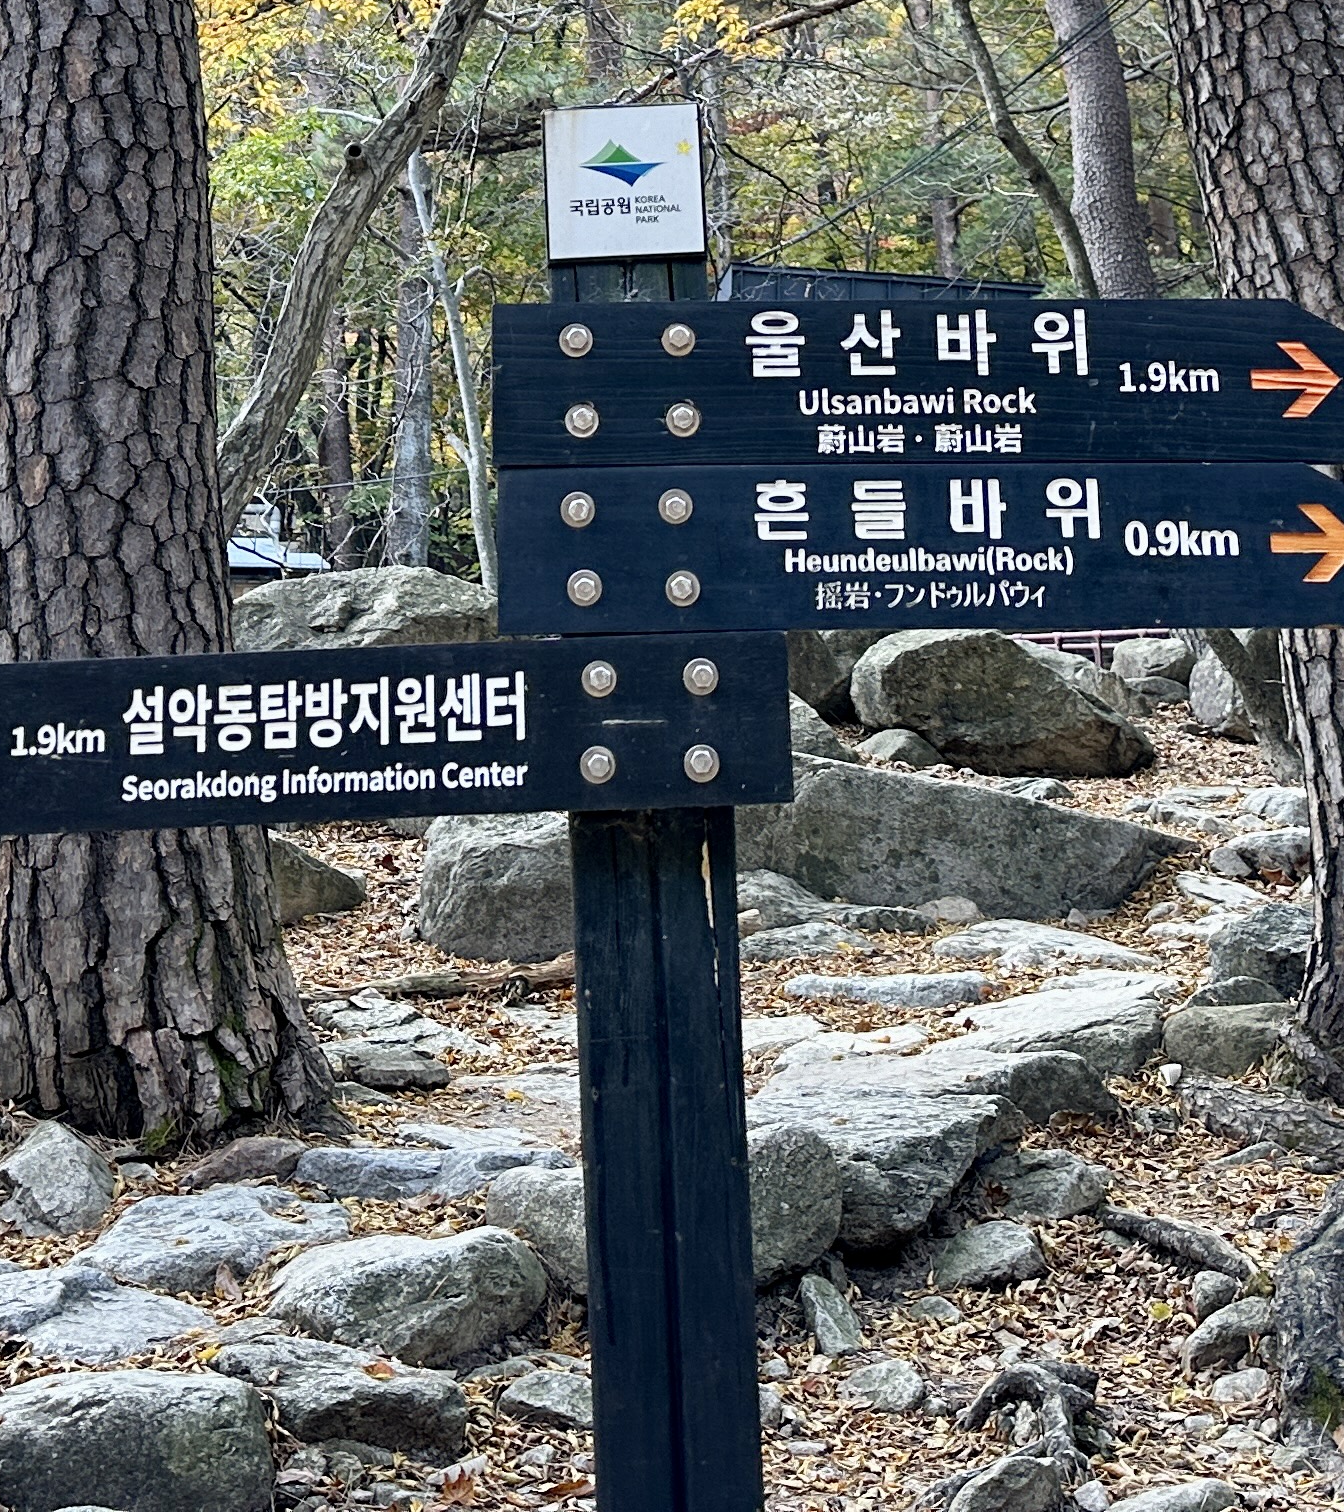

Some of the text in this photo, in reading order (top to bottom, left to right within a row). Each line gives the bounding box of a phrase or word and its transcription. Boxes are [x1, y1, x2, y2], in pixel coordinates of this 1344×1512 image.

[569, 196, 631, 216] 국립공원
[634, 194, 665, 204] KOREA
[635, 203, 682, 214] NATIONAL
[635, 214, 660, 224] PARK
[1118, 360, 1220, 393] 1.9km
[799, 386, 1037, 416] Ulsanbawi Rock
[1124, 520, 1240, 557] 0.9km
[784, 545, 1074, 576] Heundeulbawi(Rock)
[122, 670, 526, 756] 설악동탐방지원센터
[10, 722, 106, 759] 1.9km
[121, 760, 529, 804] Seorakdong Information Center
